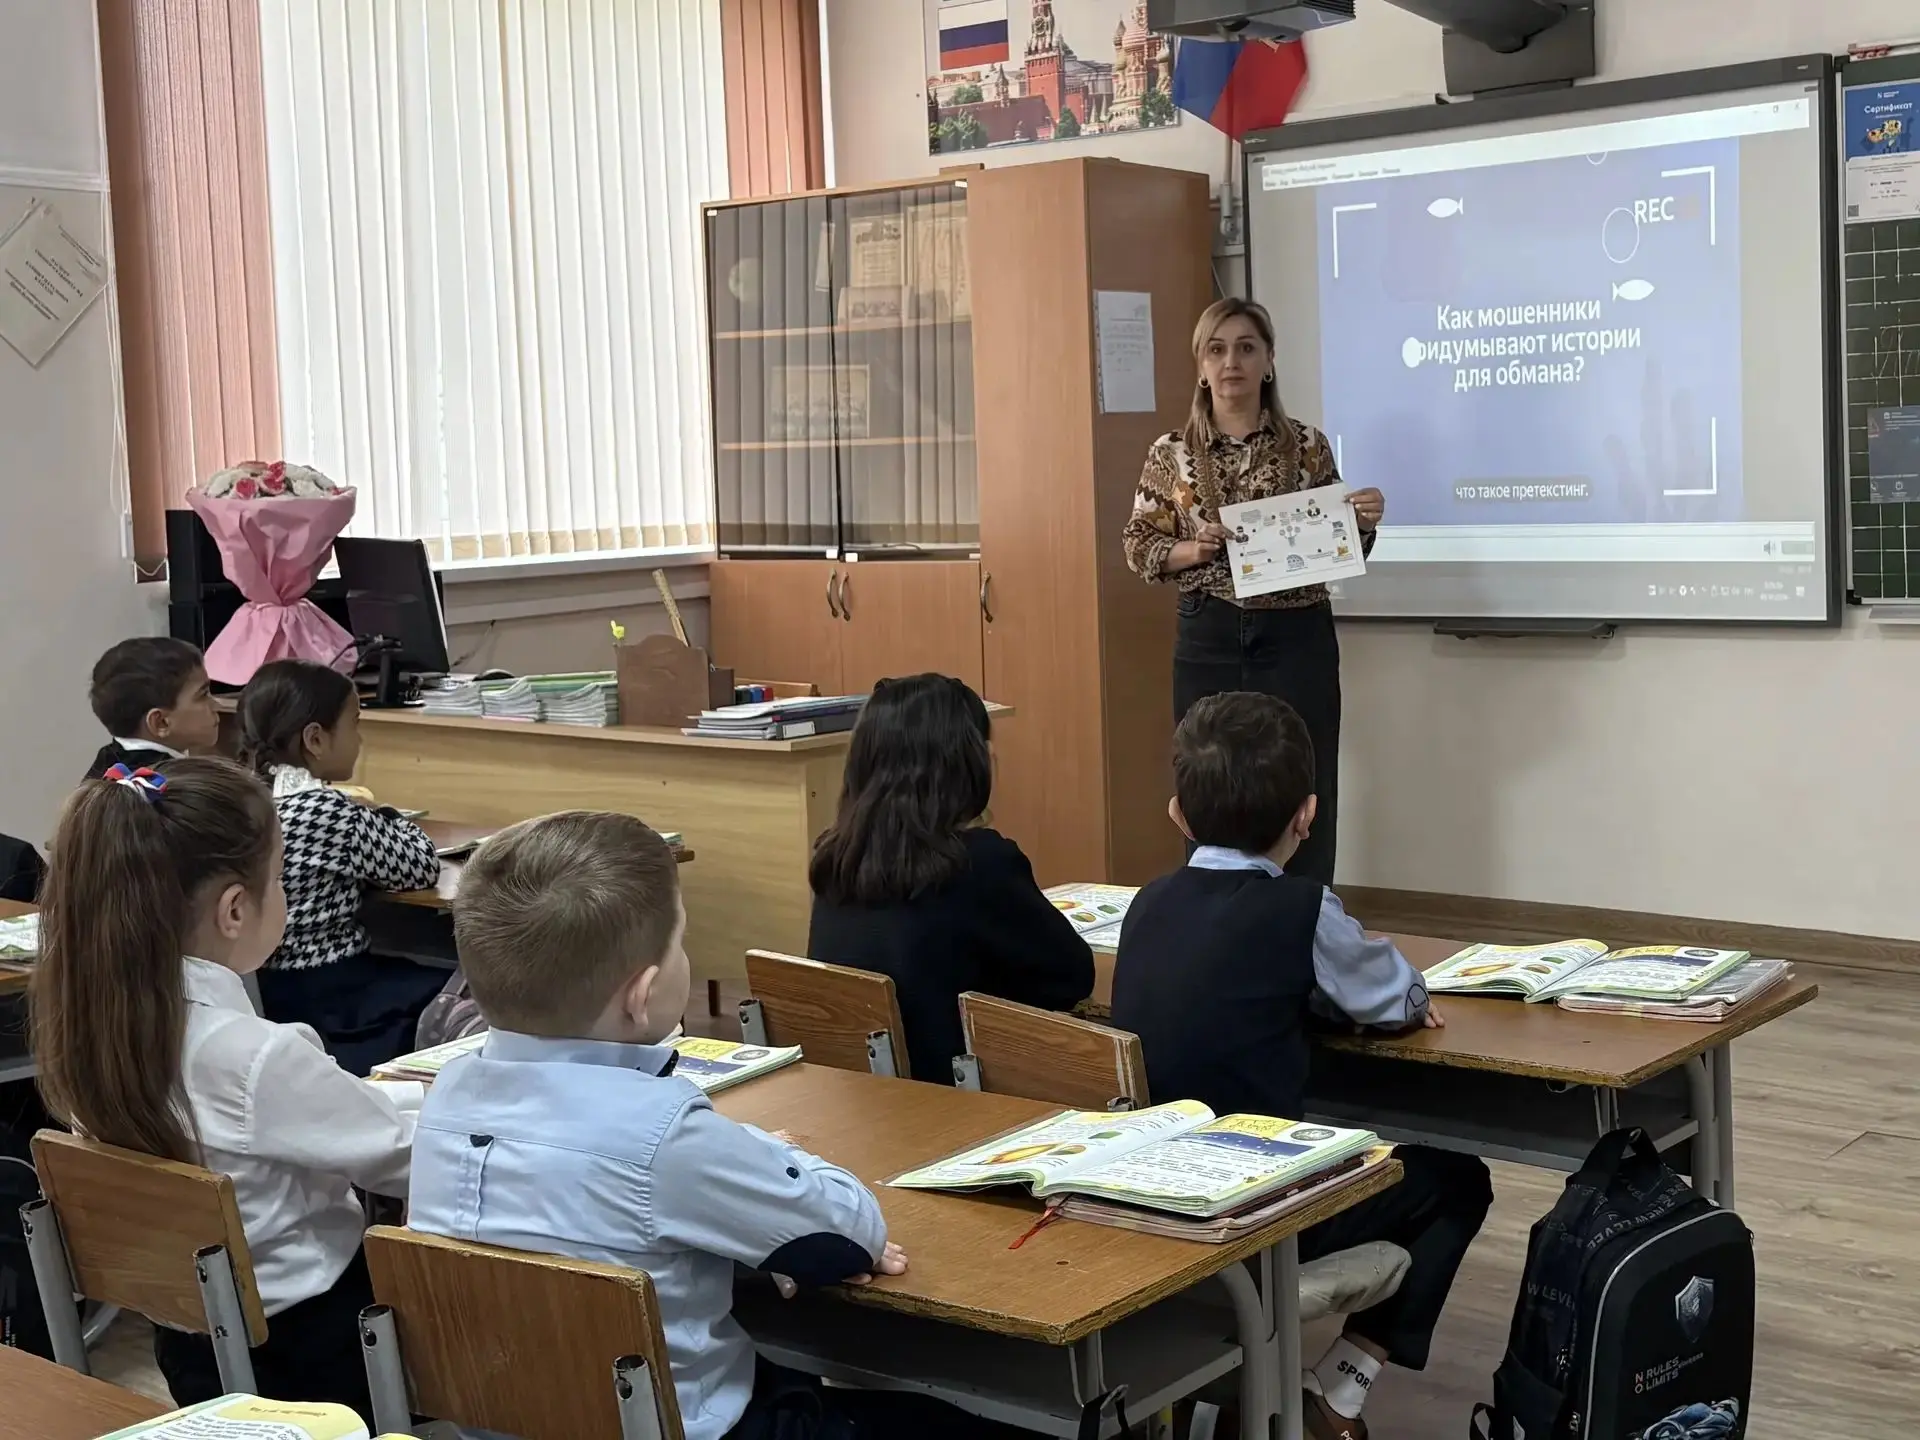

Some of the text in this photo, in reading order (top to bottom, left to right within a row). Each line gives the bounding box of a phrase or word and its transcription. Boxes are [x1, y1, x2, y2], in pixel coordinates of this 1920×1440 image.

[1864, 102, 1913, 114] Сертификат
[1634, 196, 1675, 223] REC
[1437, 299, 1601, 331] Как мошенники
[1415, 327, 1641, 364] ридумывают истории
[1454, 355, 1585, 392] для обмана?
[1455, 483, 1589, 501] что такое претекстинг.
[1635, 1371, 1644, 1384] N
[1646, 1356, 1679, 1380] RULES
[1646, 1368, 1679, 1391] LIMITS
